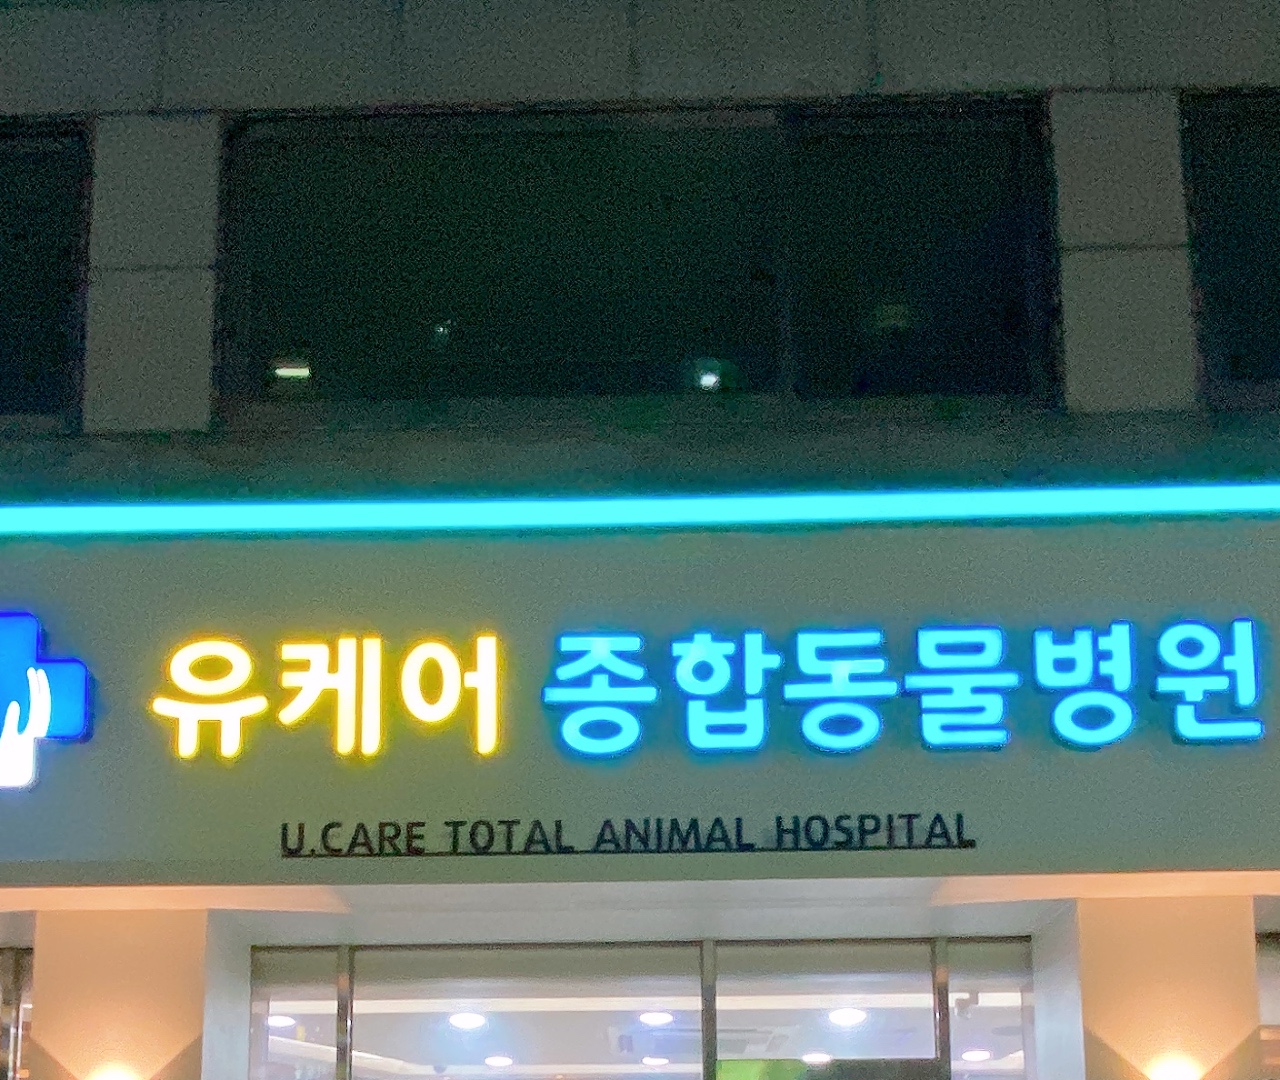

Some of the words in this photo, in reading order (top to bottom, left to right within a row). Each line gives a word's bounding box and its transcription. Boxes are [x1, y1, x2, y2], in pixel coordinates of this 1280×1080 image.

[151, 635, 498, 759] 유케어
[542, 618, 1265, 756] 종합동물병원
[279, 820, 426, 855] U.CARE
[444, 818, 575, 853] TOTAL
[593, 816, 756, 852] ANIMAL
[775, 812, 977, 850] HOSPITAL
